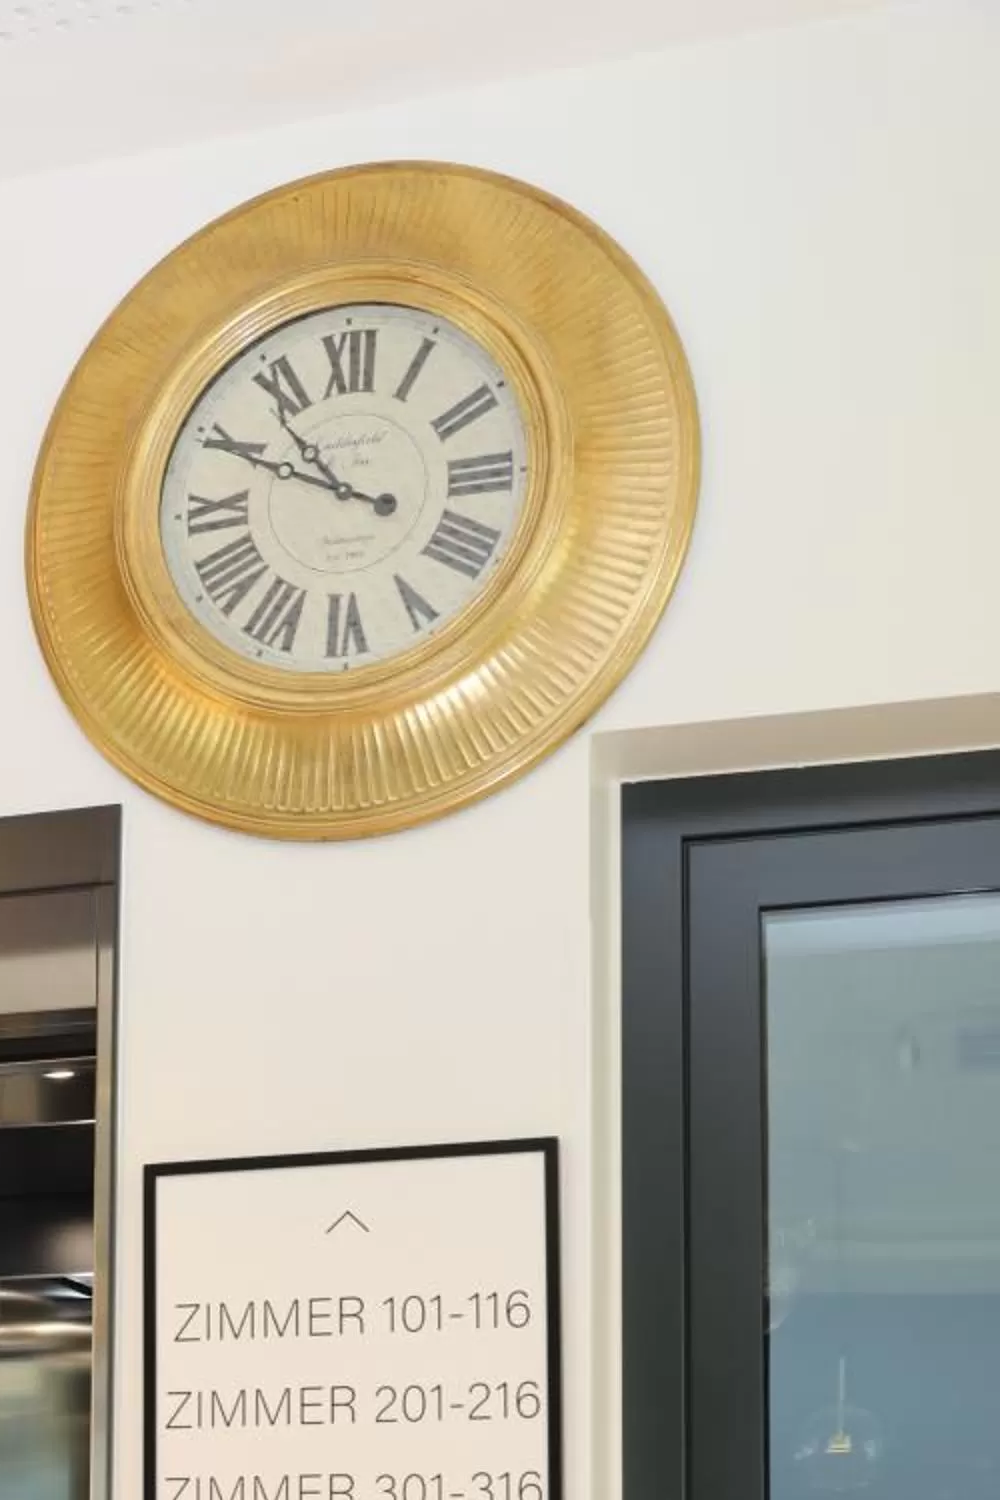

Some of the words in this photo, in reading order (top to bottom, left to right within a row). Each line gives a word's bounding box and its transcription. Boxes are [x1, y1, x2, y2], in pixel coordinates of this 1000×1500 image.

[252, 354, 313, 417] XI
[321, 329, 377, 401] XII
[393, 336, 437, 402] I
[202, 423, 267, 458] X
[430, 382, 499, 442] II
[447, 450, 514, 497] III
[187, 489, 250, 537] IX
[194, 532, 269, 617] VIII
[421, 508, 501, 580] IIII
[242, 575, 308, 653] VII
[324, 592, 369, 658] VI
[394, 574, 440, 631] V
[173, 1295, 365, 1343] ZIMMER
[382, 1289, 531, 1333] 101-116
[164, 1385, 357, 1430] ZIMMER
[374, 1380, 541, 1424] 201-216
